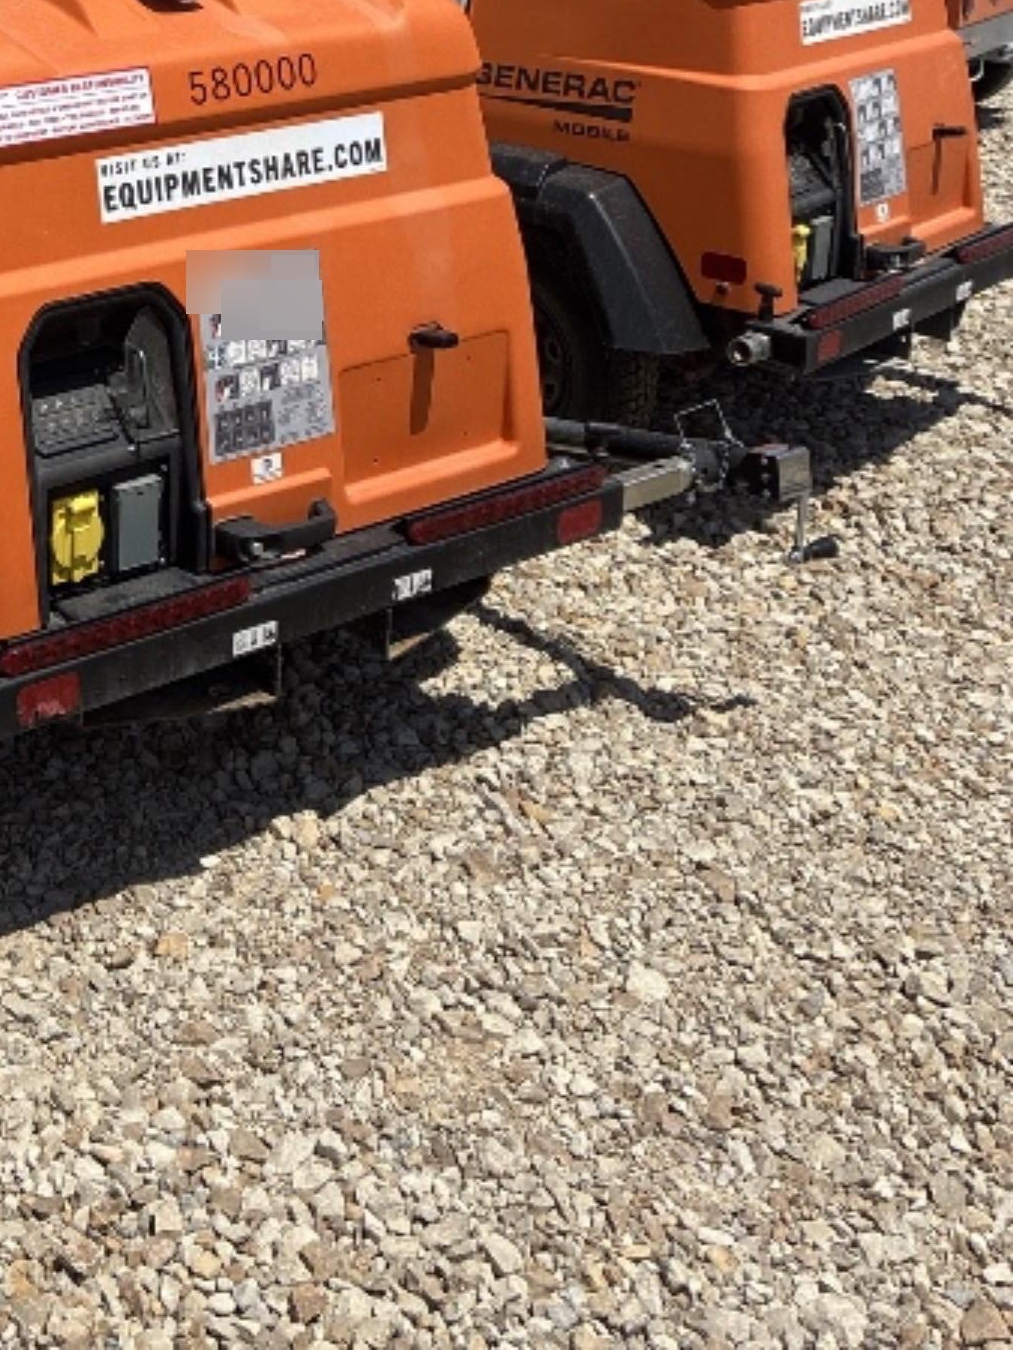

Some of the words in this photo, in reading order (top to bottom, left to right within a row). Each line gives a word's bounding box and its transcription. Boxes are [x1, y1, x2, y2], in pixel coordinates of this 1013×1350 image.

[189, 53, 318, 106] 580000
[101, 157, 138, 177] VISIT
[143, 154, 161, 170] US
[103, 138, 383, 213] EQUIPMENTSHARE.COM
